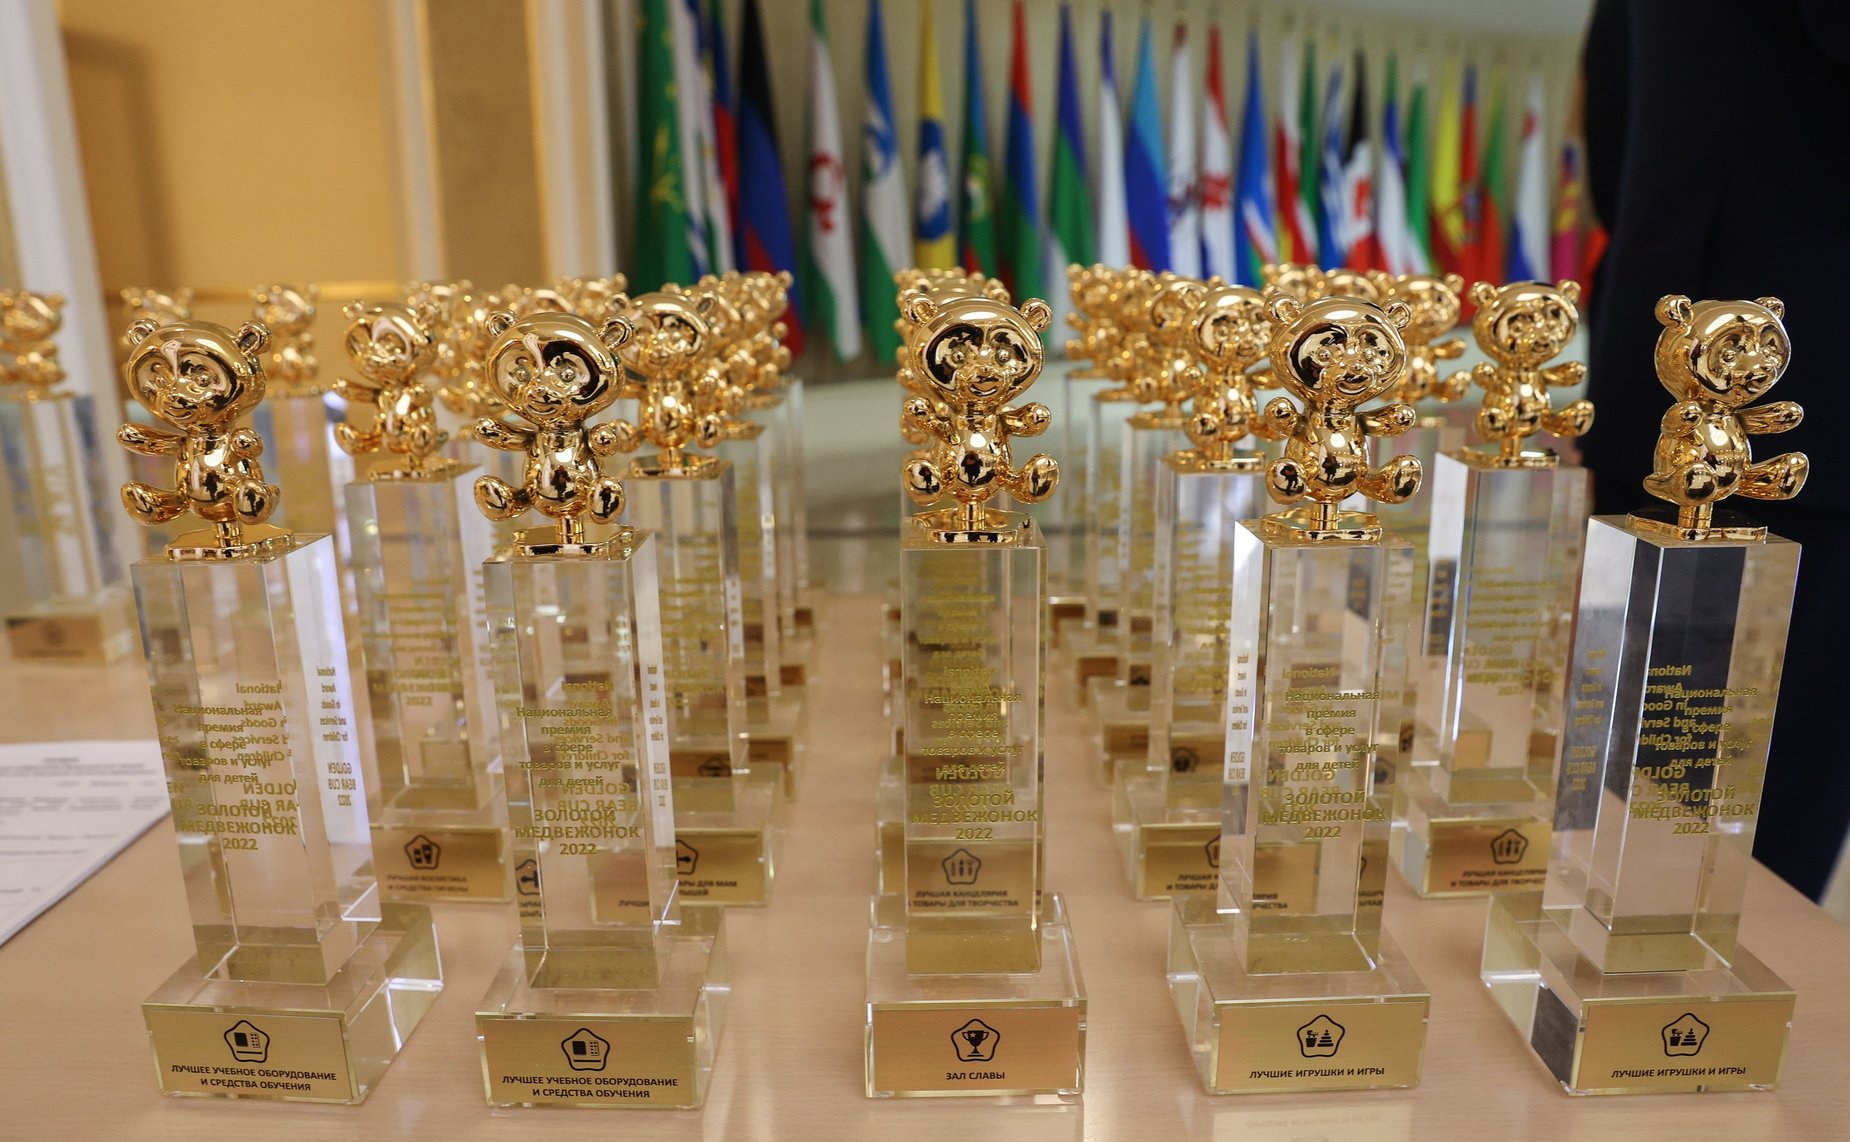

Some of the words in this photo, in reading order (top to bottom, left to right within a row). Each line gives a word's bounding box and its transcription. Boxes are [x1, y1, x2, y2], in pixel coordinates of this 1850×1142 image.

[1285, 691, 1380, 703] Национальная
[516, 707, 614, 719] Национальная
[1306, 708, 1357, 720] премия
[198, 724, 244, 735] премия
[541, 725, 592, 737] премия
[1315, 725, 1356, 738] сфере
[554, 743, 594, 755] сфере
[1279, 743, 1331, 755] товаров
[1333, 744, 1343, 753] и
[1708, 741, 1717, 750] и
[519, 760, 572, 772] товаров
[574, 761, 584, 770] и
[587, 760, 621, 772] услуг
[1294, 761, 1320, 772] для
[1322, 759, 1361, 772] детей
[199, 774, 222, 784] для
[224, 772, 260, 784] детей
[566, 775, 605, 788] детей
[1285, 789, 1366, 807] ЗОЛОТОЙ
[197, 803, 273, 819] ЗОЛОТОЙ
[534, 807, 617, 823] ЗОЛОТОЙ
[911, 809, 1039, 826] МЕДВЕЖОНОК
[1262, 807, 1387, 825] МЕДВЕЖОНОК
[1633, 804, 1756, 821] МЕДВЕЖОНОК
[176, 821, 298, 836] МЕДВЕЖОНОК
[515, 826, 641, 841] МЕДВЕЖОНОК
[955, 827, 994, 841] 2022
[1304, 826, 1343, 841] 2022
[1672, 821, 1710, 835] 2022
[223, 838, 259, 851] 2022
[560, 842, 598, 856] 2022
[171, 1064, 211, 1074] ЛУЧШЕЕ
[212, 1066, 256, 1077] УЧЕБНОЕ
[258, 1068, 337, 1081] ОБОРУДОВАНИЕ
[945, 1072, 967, 1081] ЗАЛ
[968, 1071, 1005, 1081] СЛАВЫ
[1248, 1070, 1293, 1080] ЛУЧШИЕ
[1295, 1068, 1345, 1079] ИГРУШКИ
[1346, 1067, 1355, 1076] И
[1356, 1066, 1386, 1076] ИГРЫ
[1610, 1068, 1655, 1079] ЛУЧШИЕ
[1657, 1067, 1706, 1078] ИГРУШКИ
[1707, 1067, 1717, 1076] И
[1718, 1066, 1747, 1076] ИГРЫ
[200, 1078, 208, 1086] И
[210, 1079, 258, 1089] СРЕДСТВА
[259, 1081, 312, 1092] ОБУЧЕНИЯ
[502, 1075, 545, 1085] ЛУЧШЕЕ
[546, 1076, 592, 1086] УЧЕБНОЕ
[594, 1076, 679, 1088] ОБОРУДОВАНИЕ
[532, 1088, 540, 1097] И
[542, 1088, 593, 1098] СРЕДСТВА
[595, 1089, 650, 1099] ОБУЧЕНИЯ
